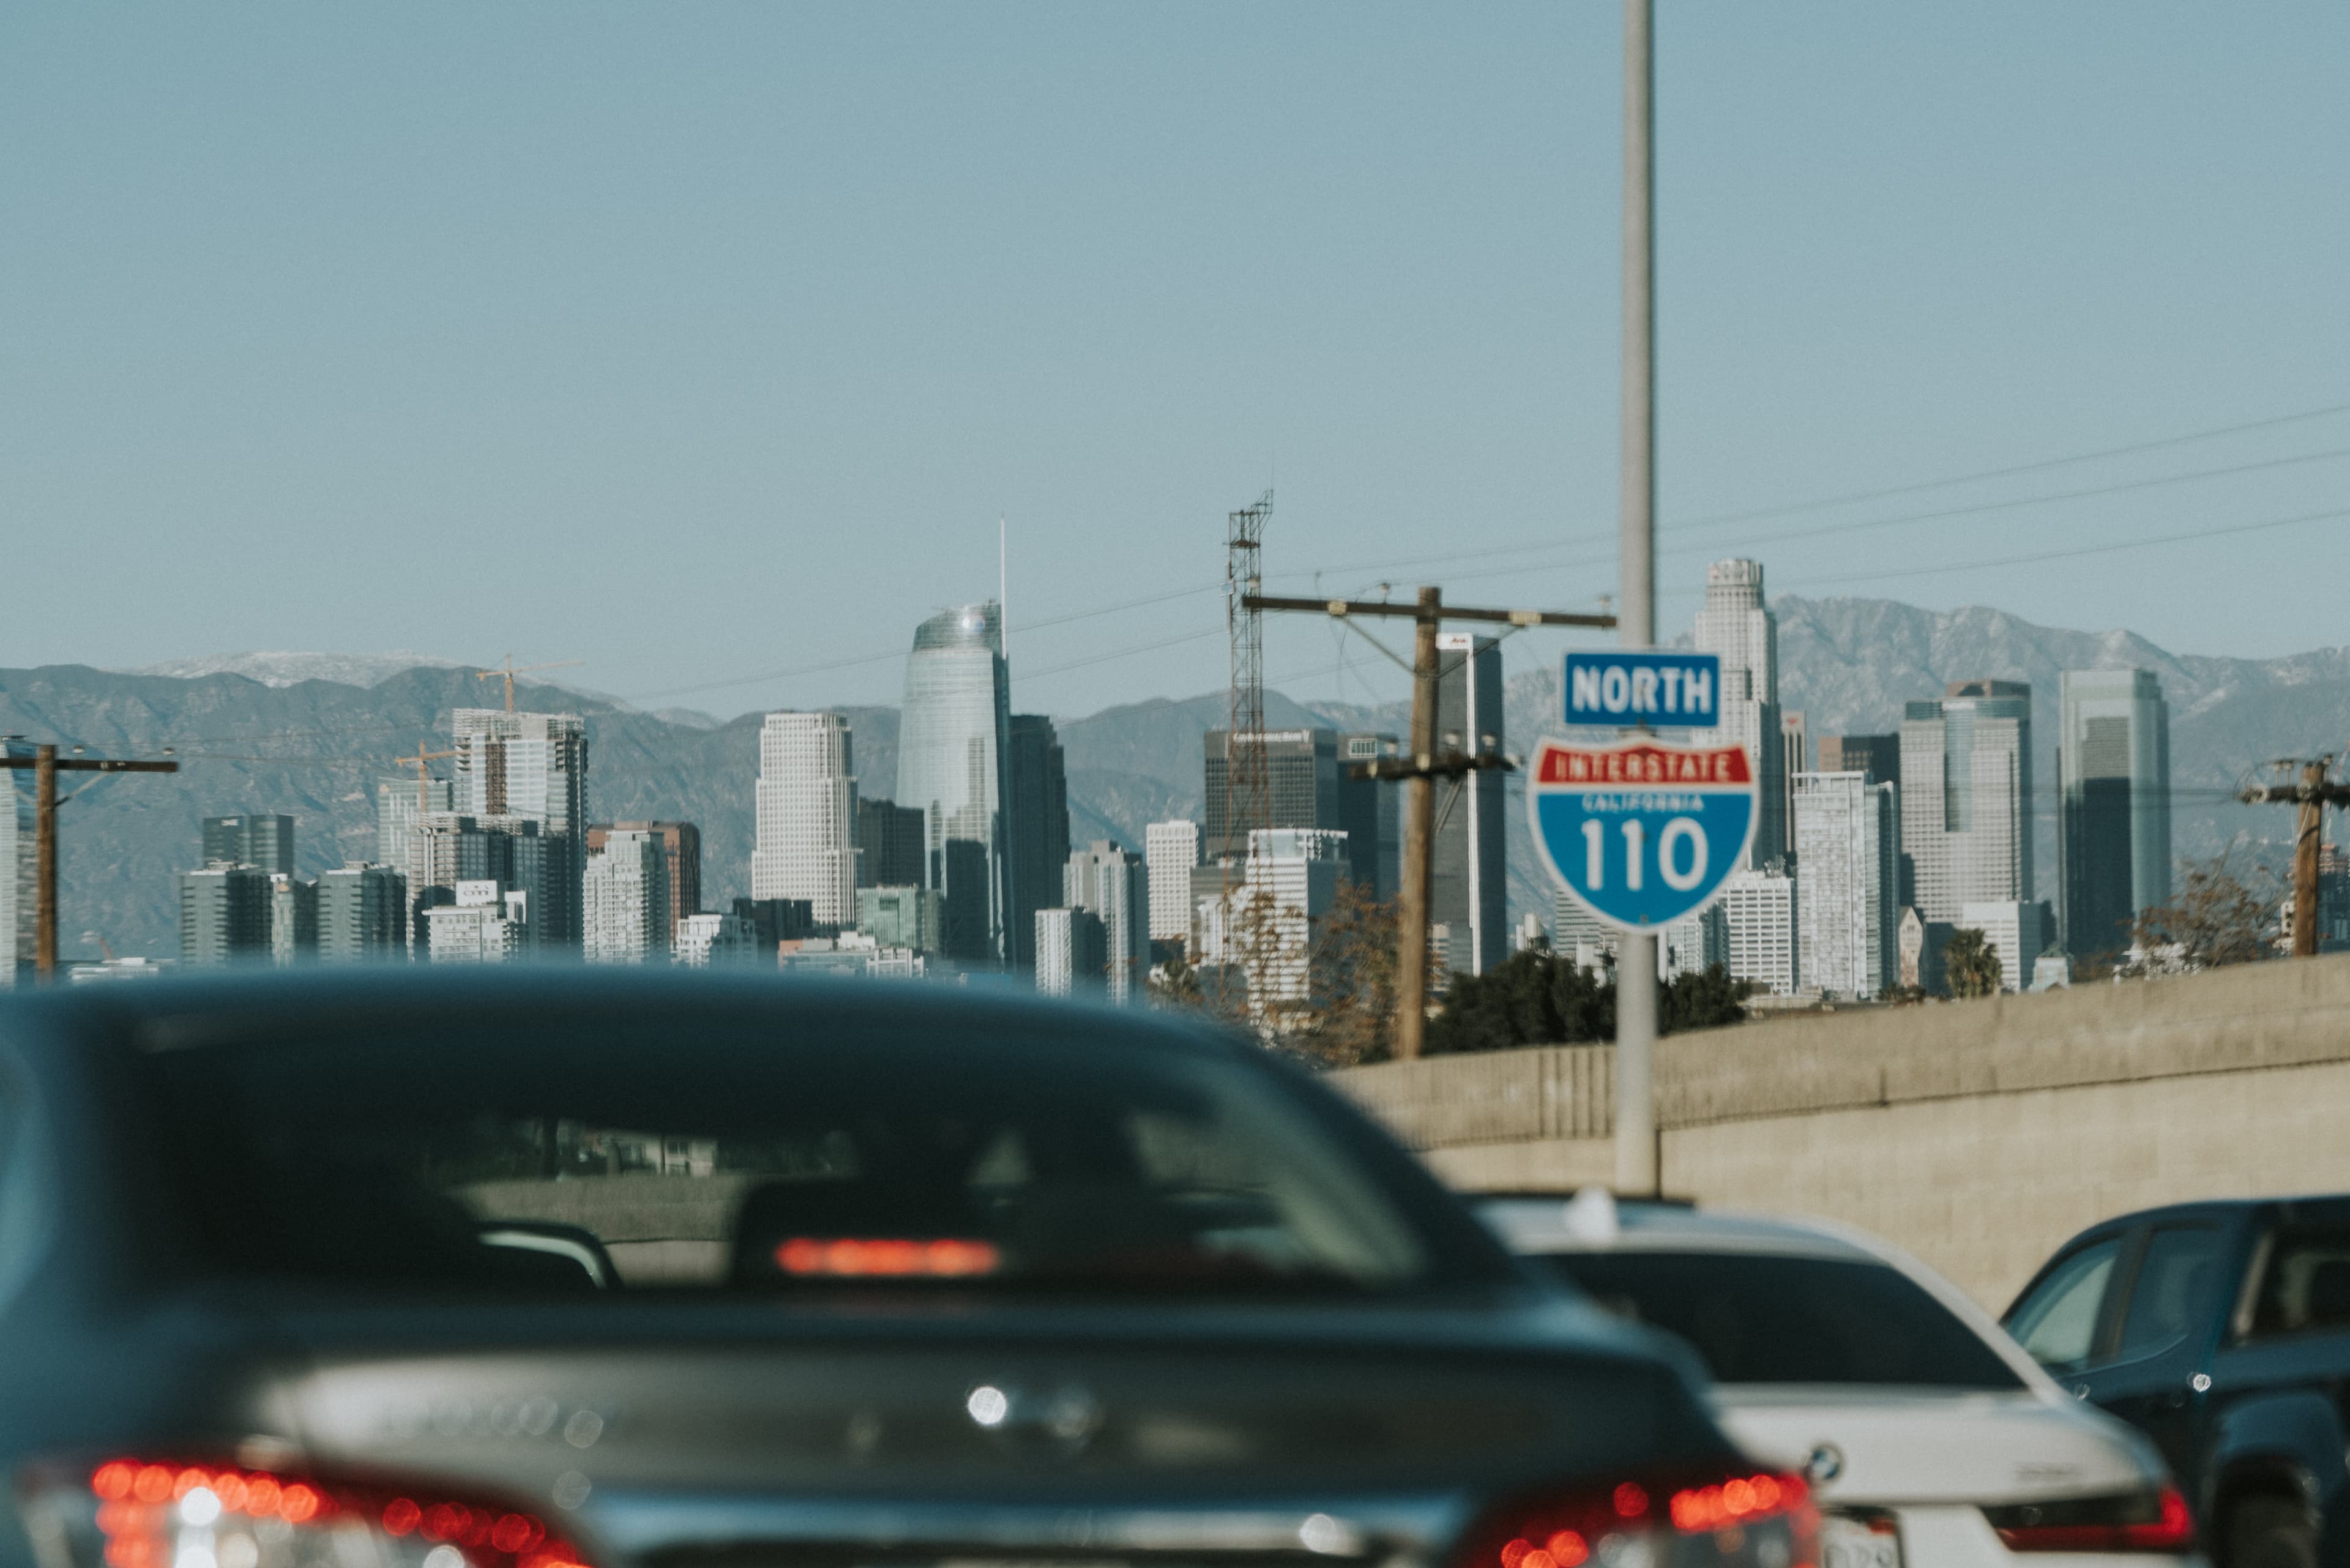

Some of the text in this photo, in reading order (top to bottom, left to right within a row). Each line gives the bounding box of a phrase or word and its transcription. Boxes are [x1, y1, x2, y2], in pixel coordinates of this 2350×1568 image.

[1572, 665, 1712, 714] NORTH
[1555, 753, 1733, 780] INTERSTATE
[1581, 794, 1704, 813] CALIFORNIA
[1581, 816, 1709, 892] 110
